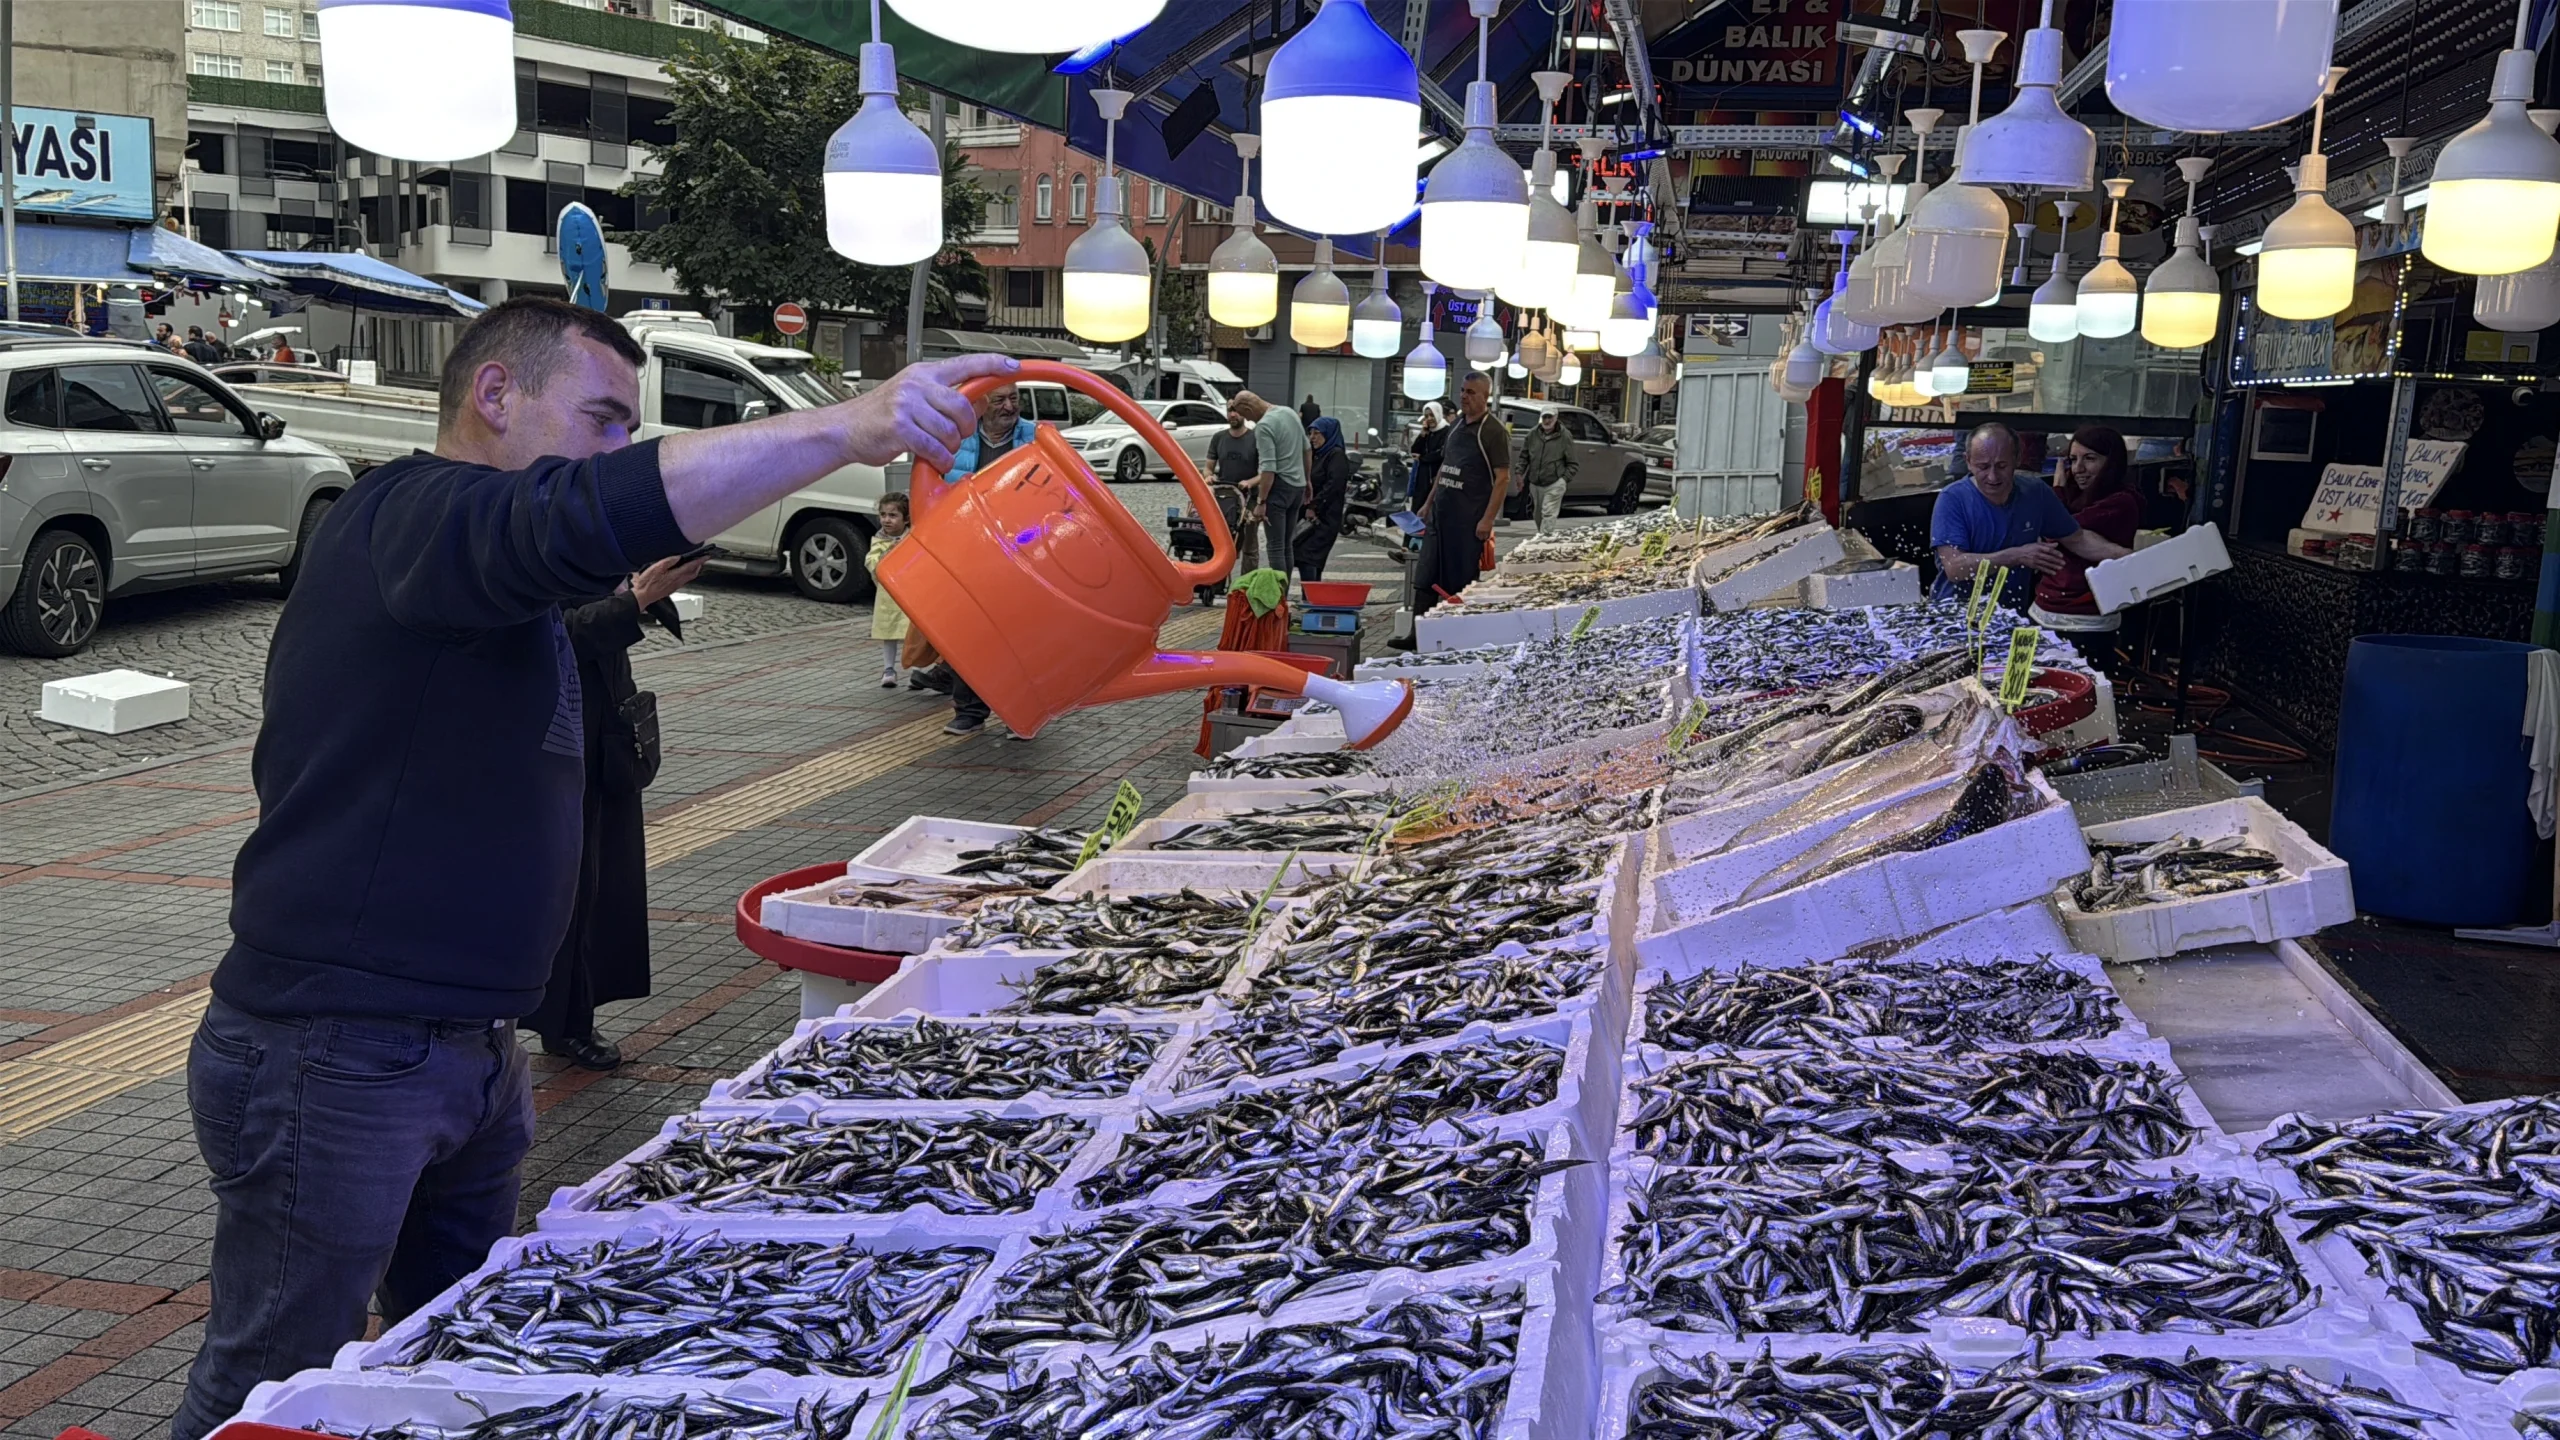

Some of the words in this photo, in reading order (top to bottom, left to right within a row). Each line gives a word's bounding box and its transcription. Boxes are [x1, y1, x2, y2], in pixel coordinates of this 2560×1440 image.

[1725, 25, 1827, 49] BALIK
[0, 122, 112, 183] YASI
[1448, 298, 1466, 312] ÜST
[1466, 302, 1479, 313] KA
[2285, 322, 2330, 370] Ekmek
[2409, 442, 2448, 465] BALIK
[2324, 468, 2355, 487] BALIK
[2343, 490, 2369, 510] KAT
[1107, 800, 1133, 837] 500
